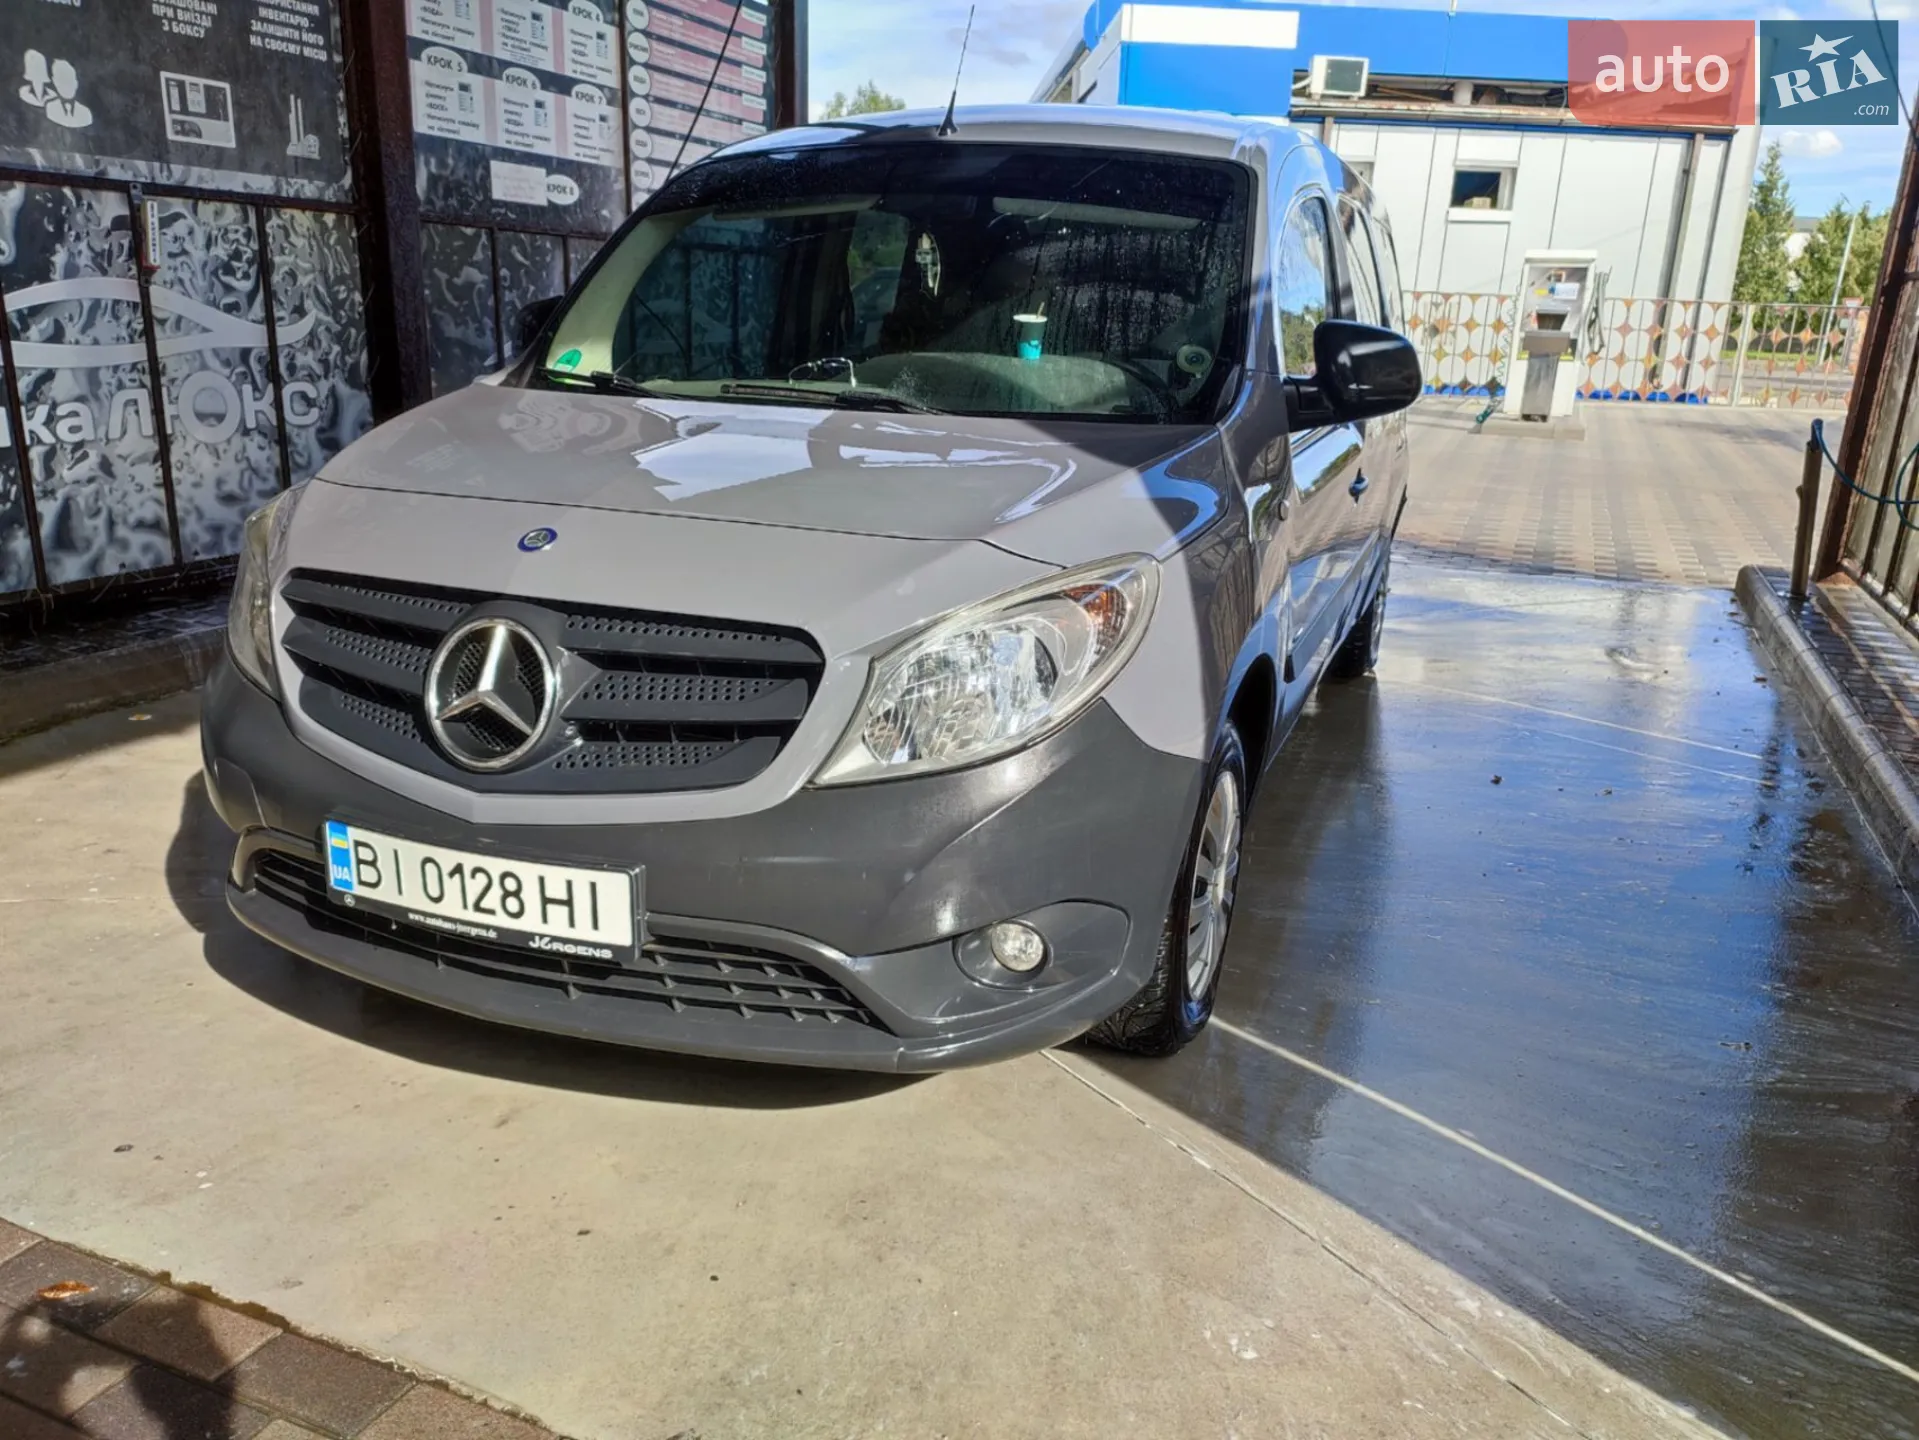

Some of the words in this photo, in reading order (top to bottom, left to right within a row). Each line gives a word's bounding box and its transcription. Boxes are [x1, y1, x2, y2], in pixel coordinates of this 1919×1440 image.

[152, 3, 174, 18] ПРИ
[177, 9, 212, 27] ВИЇЗДІ
[258, 6, 309, 28] ІНВЕНТАРЮ
[572, 6, 593, 21] КРОК
[172, 21, 205, 38] БОКСУ
[250, 19, 300, 40] ЗАЛИШИТИ
[301, 29, 324, 46] ЙОГО
[249, 34, 263, 47] НА
[264, 38, 301, 55] СВОЄМУ
[426, 54, 453, 70] КРОК
[457, 62, 463, 73] 5
[505, 74, 528, 89] КРОК
[531, 80, 538, 90] 6
[575, 91, 596, 104] КРОК
[597, 96, 603, 105] 7
[547, 183, 568, 195] КРОК
[333, 865, 352, 884] UA
[352, 839, 404, 897] BI
[420, 856, 525, 920] 0128
[538, 875, 599, 931] HI
